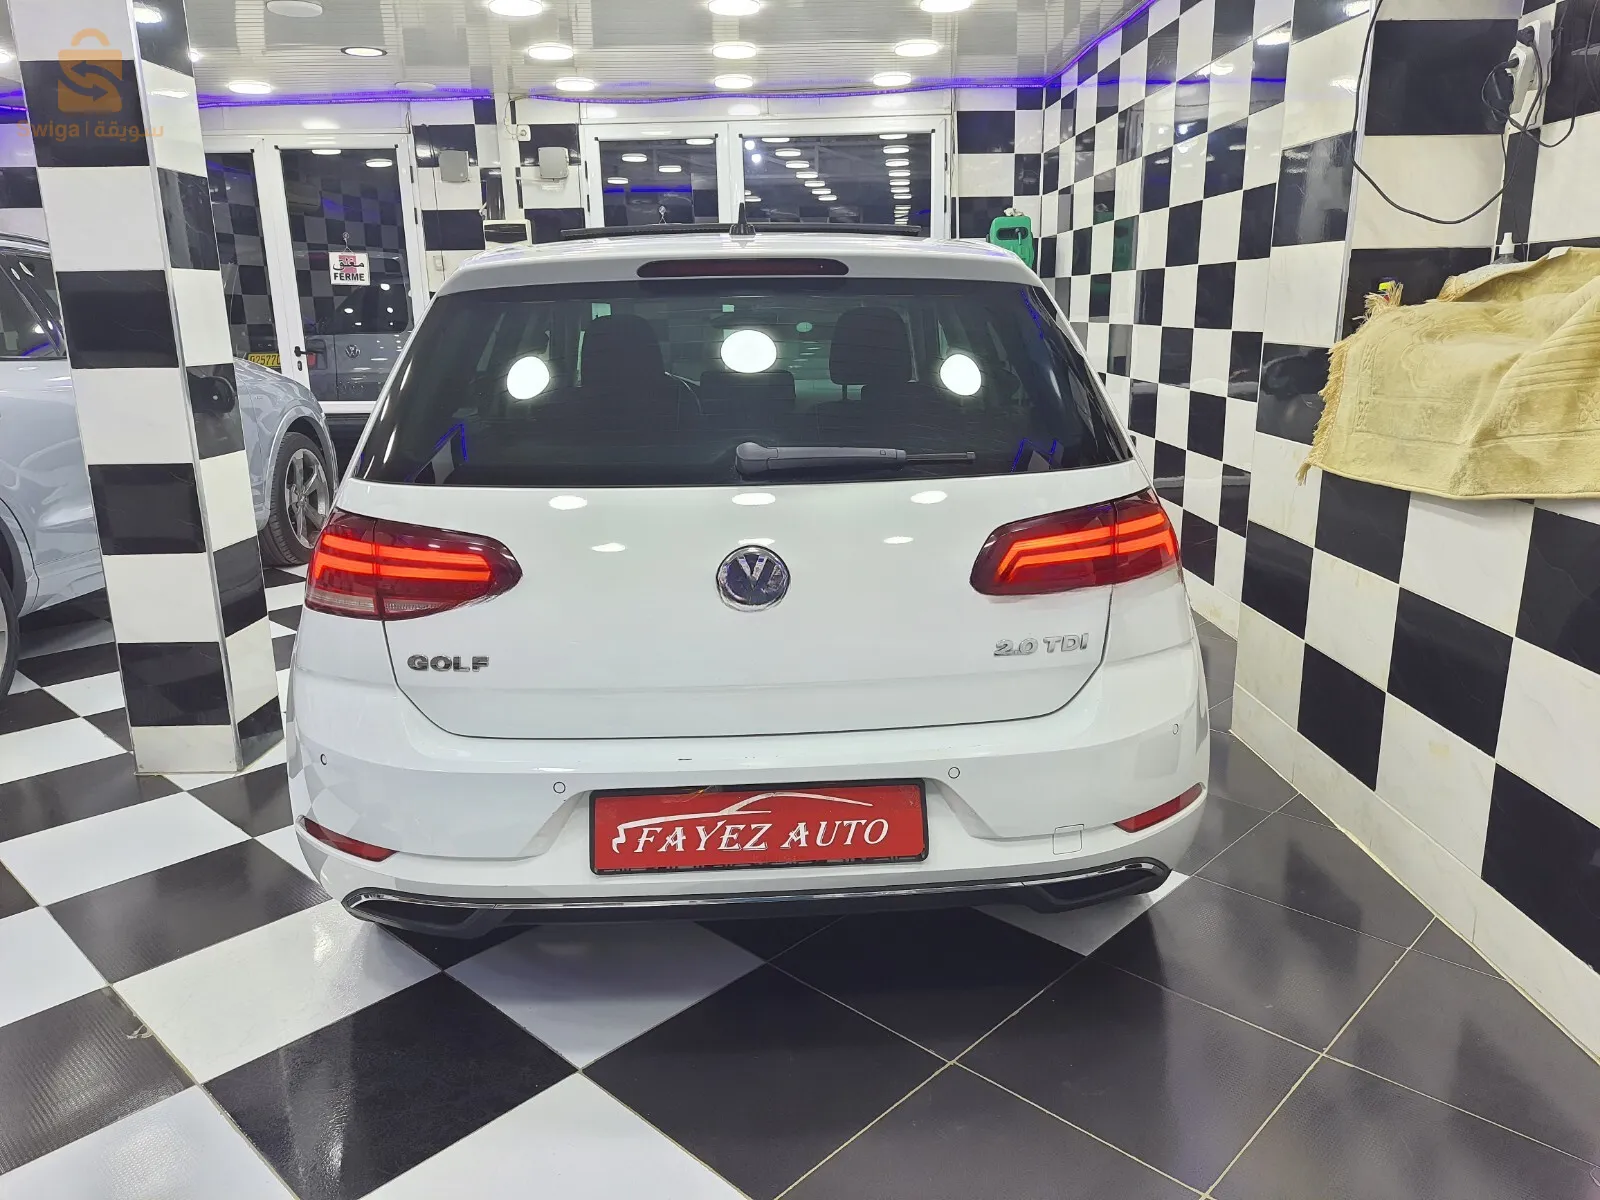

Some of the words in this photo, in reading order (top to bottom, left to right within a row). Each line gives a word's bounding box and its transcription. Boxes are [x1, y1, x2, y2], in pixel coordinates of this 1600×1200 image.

[334, 272, 365, 281] FERME
[994, 637, 1039, 656] 2.0
[1043, 632, 1089, 653] TDI
[407, 654, 490, 672] GOLF
[633, 820, 773, 853] FAYEZ
[780, 819, 889, 849] AUTO
